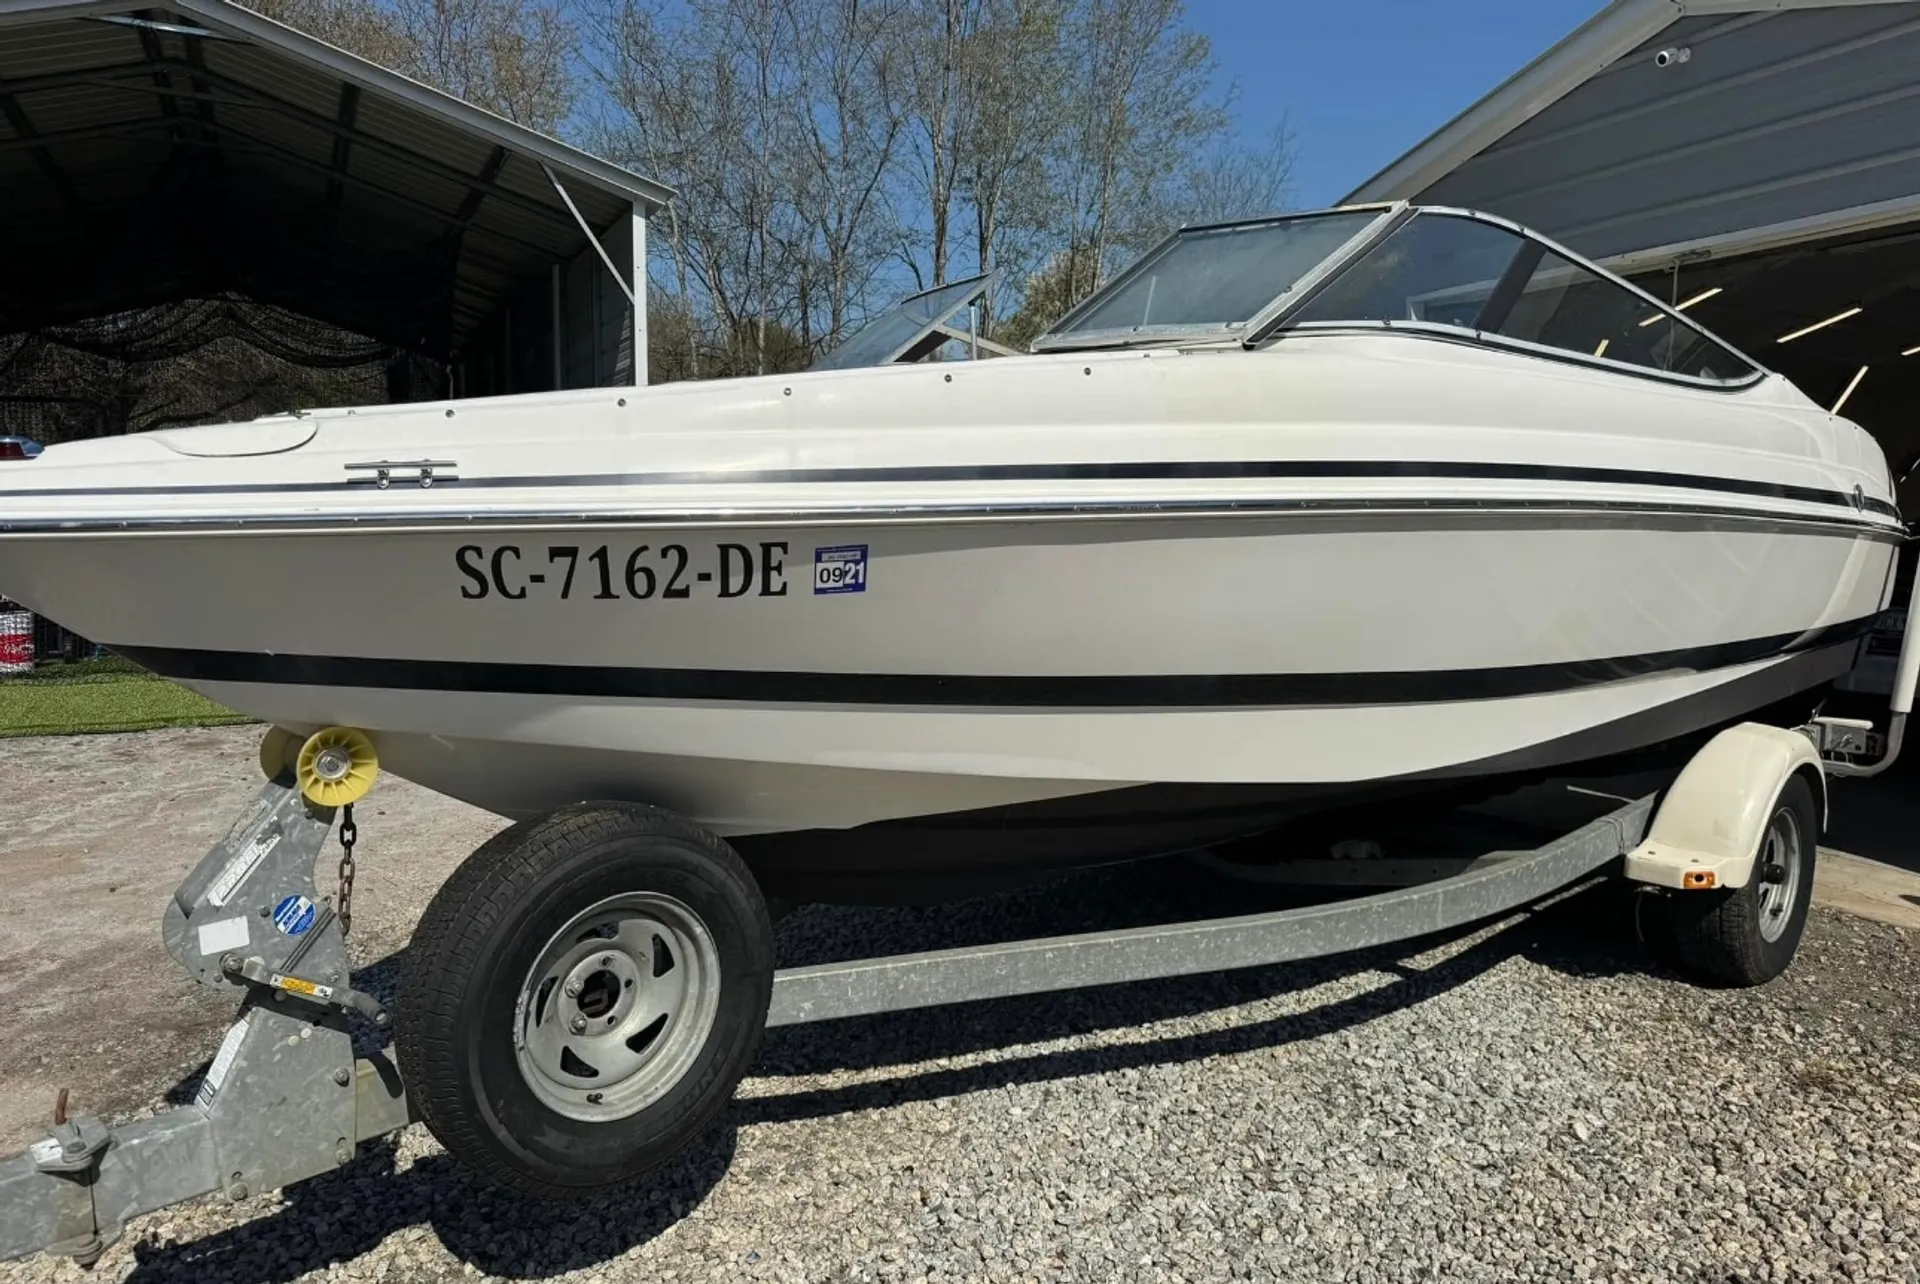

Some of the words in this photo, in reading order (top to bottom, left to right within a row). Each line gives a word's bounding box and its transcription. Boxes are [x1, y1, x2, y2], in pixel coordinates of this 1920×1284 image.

[455, 541, 788, 599] SC-7162-DE
[819, 566, 843, 584] 09
[844, 561, 865, 584] 21
